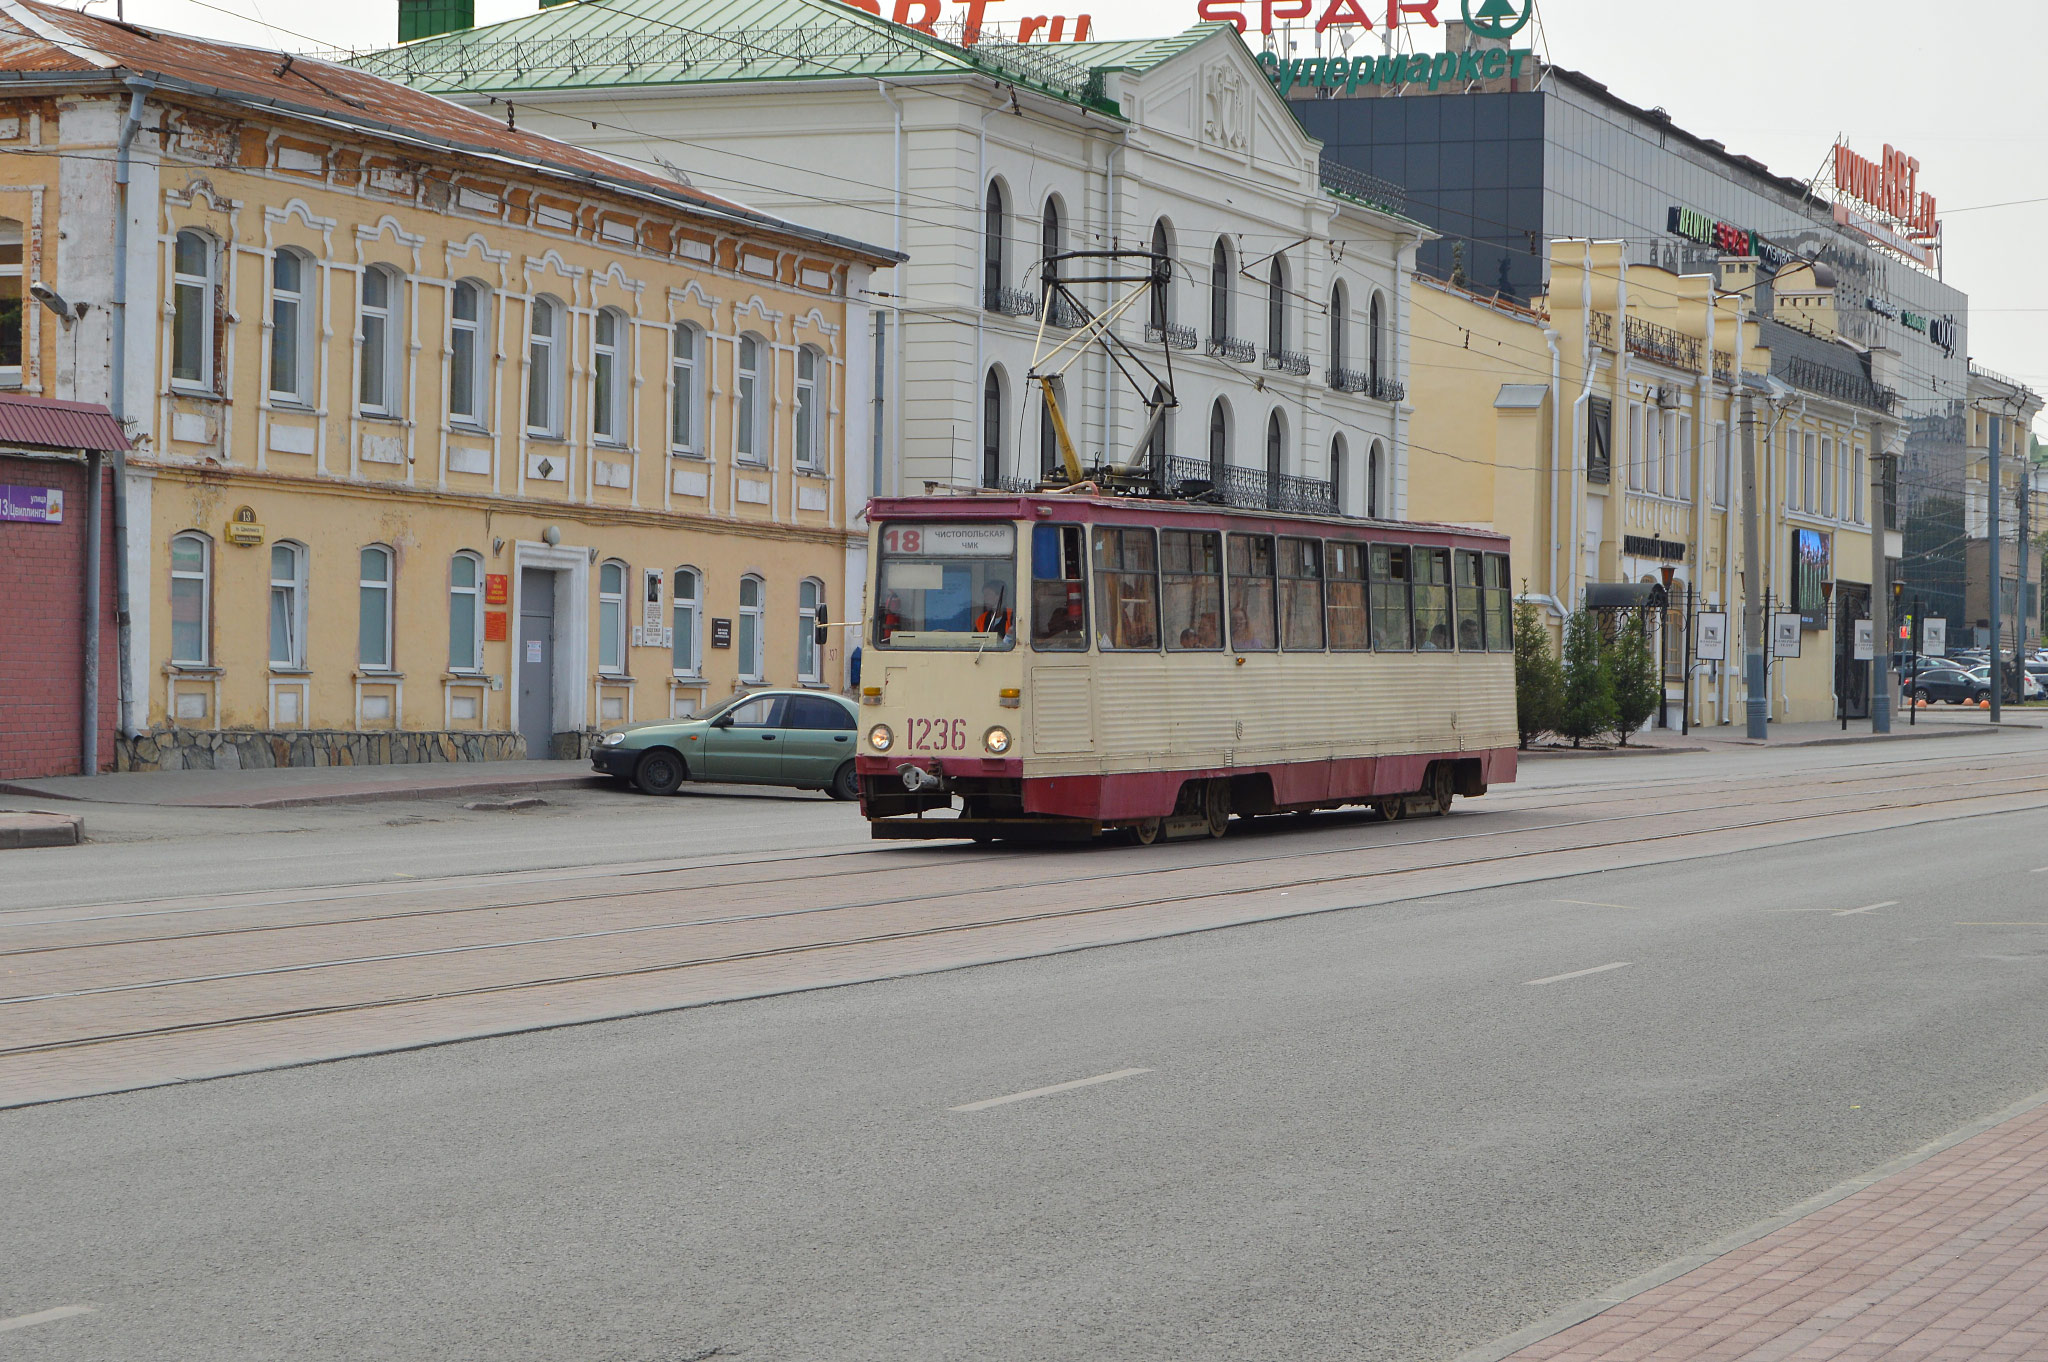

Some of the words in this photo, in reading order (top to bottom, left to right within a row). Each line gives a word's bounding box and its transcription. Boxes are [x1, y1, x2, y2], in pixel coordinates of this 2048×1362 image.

[1198, 0, 1438, 35] SPAR
[1256, 47, 1532, 97] Супермаркет
[30, 495, 47, 504] улица
[10, 503, 46, 518] Цвиллинга
[242, 511, 251, 522] 13
[885, 530, 920, 552] 18
[935, 530, 1006, 538] ЧИСТОПОЛЬСКАЯ
[907, 718, 967, 750] 1236
